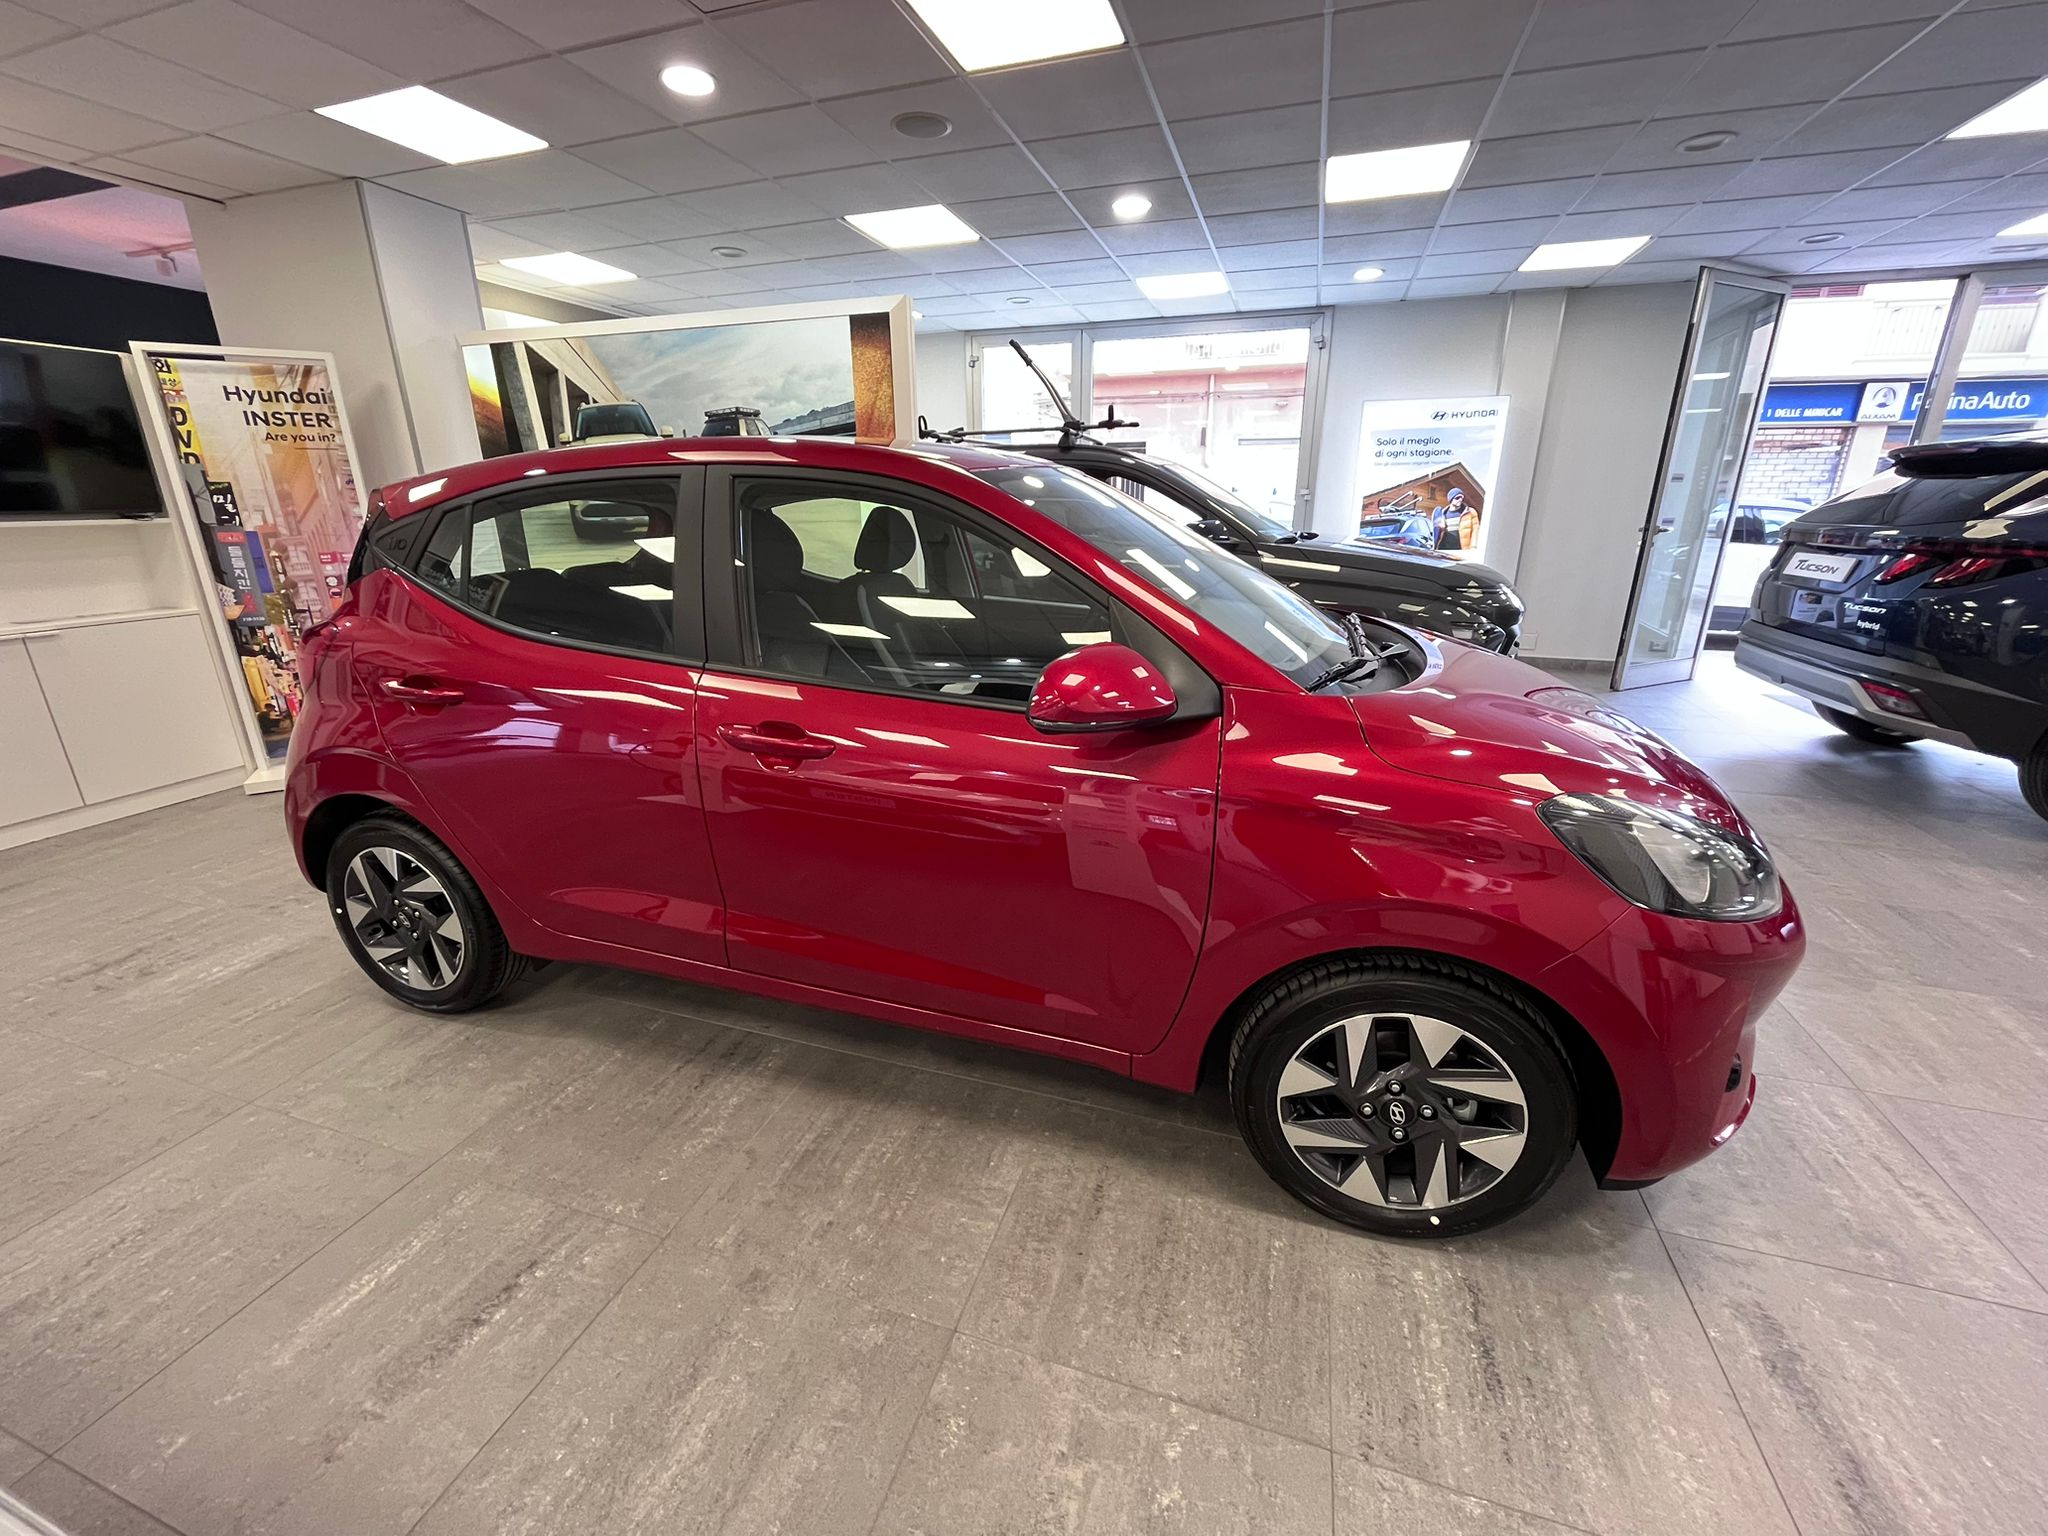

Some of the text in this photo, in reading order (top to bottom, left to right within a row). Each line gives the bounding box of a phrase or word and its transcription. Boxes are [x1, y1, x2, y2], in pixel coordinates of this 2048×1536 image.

[222, 385, 328, 405] Hyundai
[1451, 409, 1499, 419] HYUNDAI
[1774, 408, 1803, 418] DELLE
[242, 410, 334, 428] INSTER
[265, 432, 336, 443] Are you in?
[1376, 436, 1441, 446] Solo il meglio
[1375, 449, 1384, 458] di
[1386, 450, 1407, 459] ogni
[1857, 620, 1880, 630] hybrid
